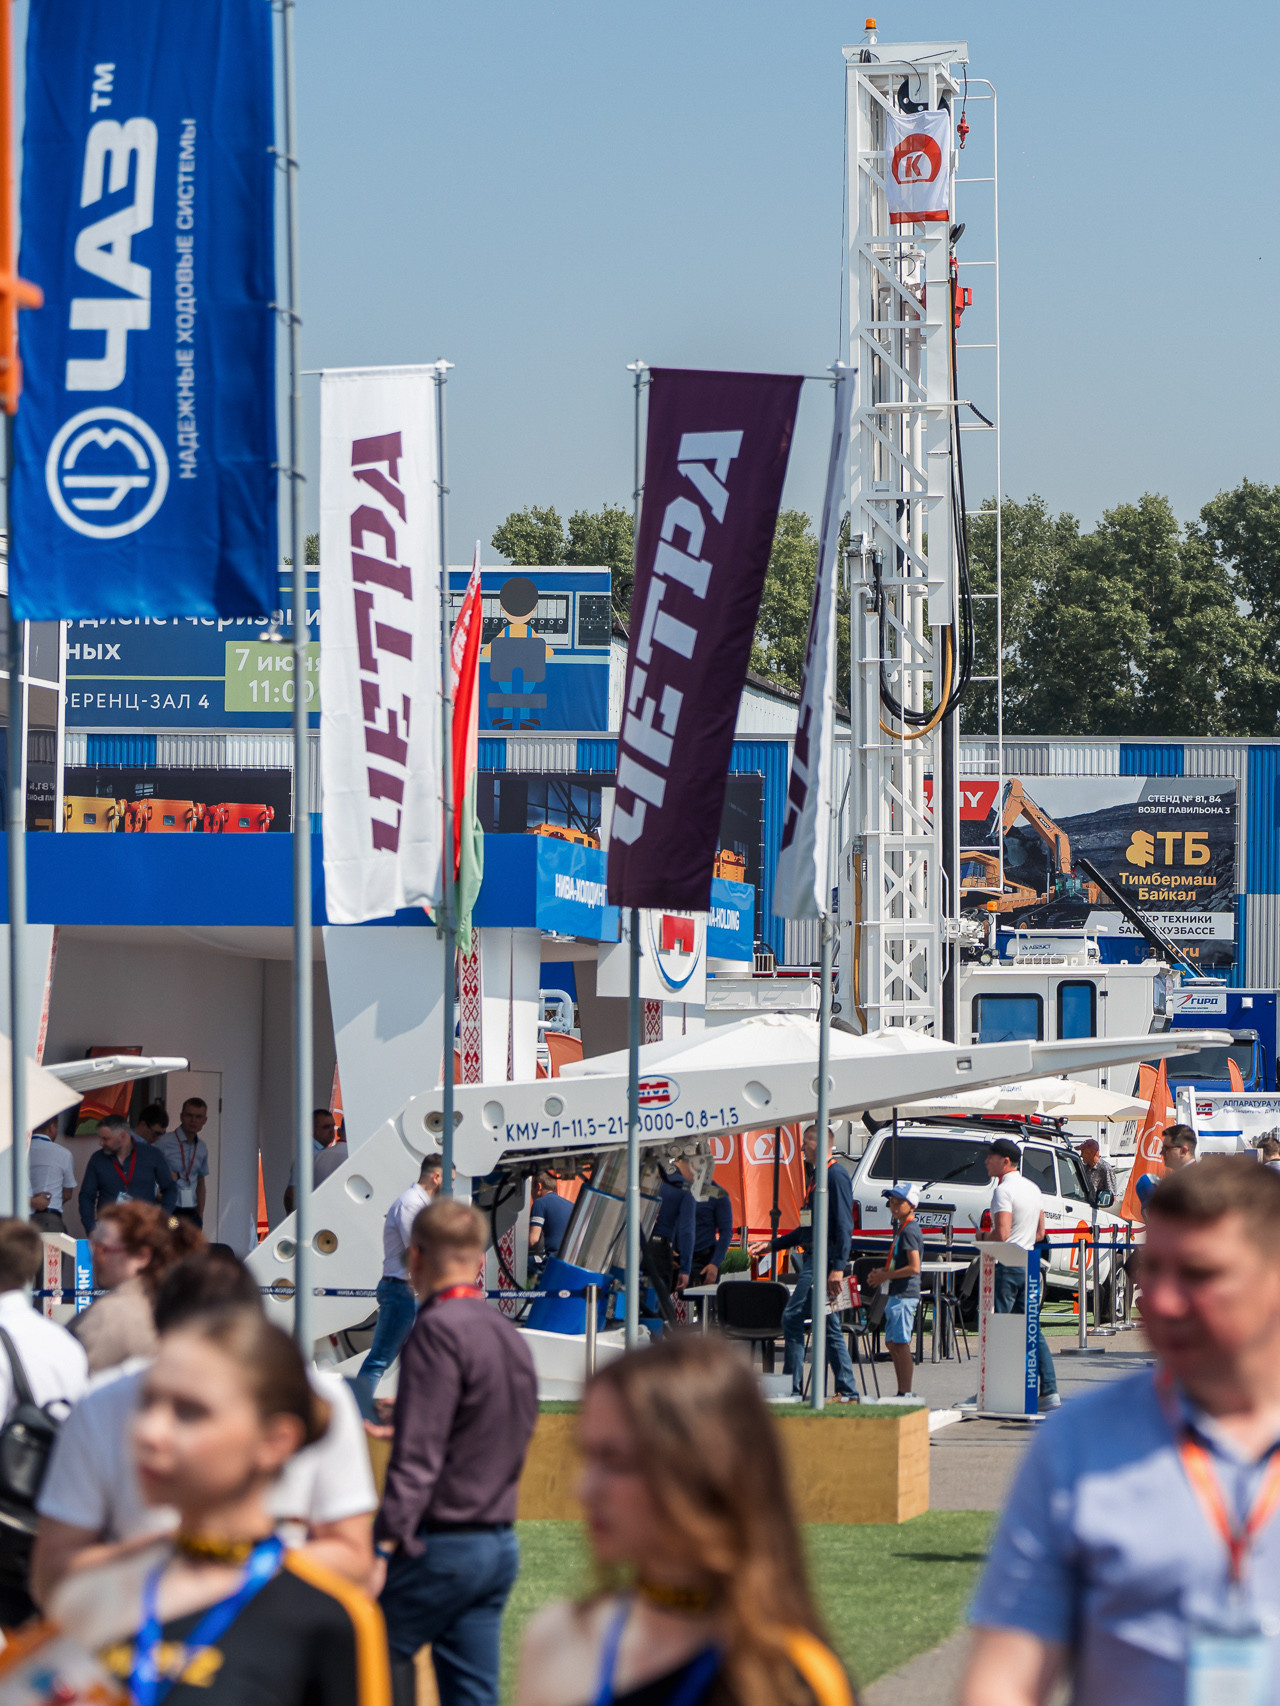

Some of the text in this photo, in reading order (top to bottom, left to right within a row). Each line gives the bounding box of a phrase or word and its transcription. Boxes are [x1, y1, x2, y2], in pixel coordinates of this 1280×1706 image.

[65, 117, 159, 392] ЧАЗ
[176, 118, 201, 479] НАДЕЖНЫЕ ХОДОВЫЕ СИСТЕМЫ
[350, 431, 413, 854] ЧЕТРА
[611, 429, 744, 847] ЧЕТРА
[235, 649, 251, 671] 7
[198, 697, 209, 709] 4
[1147, 794, 1180, 803] СТЕНД
[1194, 795, 1207, 804] 81,
[1208, 795, 1222, 803] 84
[1138, 806, 1167, 814] ВОЗЛЕ
[1119, 872, 1217, 888] Тимбермаш
[1138, 887, 1197, 901] Байкал
[1121, 915, 1212, 924] ДЛЕР ТЕХНИКИ
[1159, 926, 1216, 935] КУЗБАССЕ
[1027, 1274, 1039, 1388] НИВА-ХОЛДИНГ
